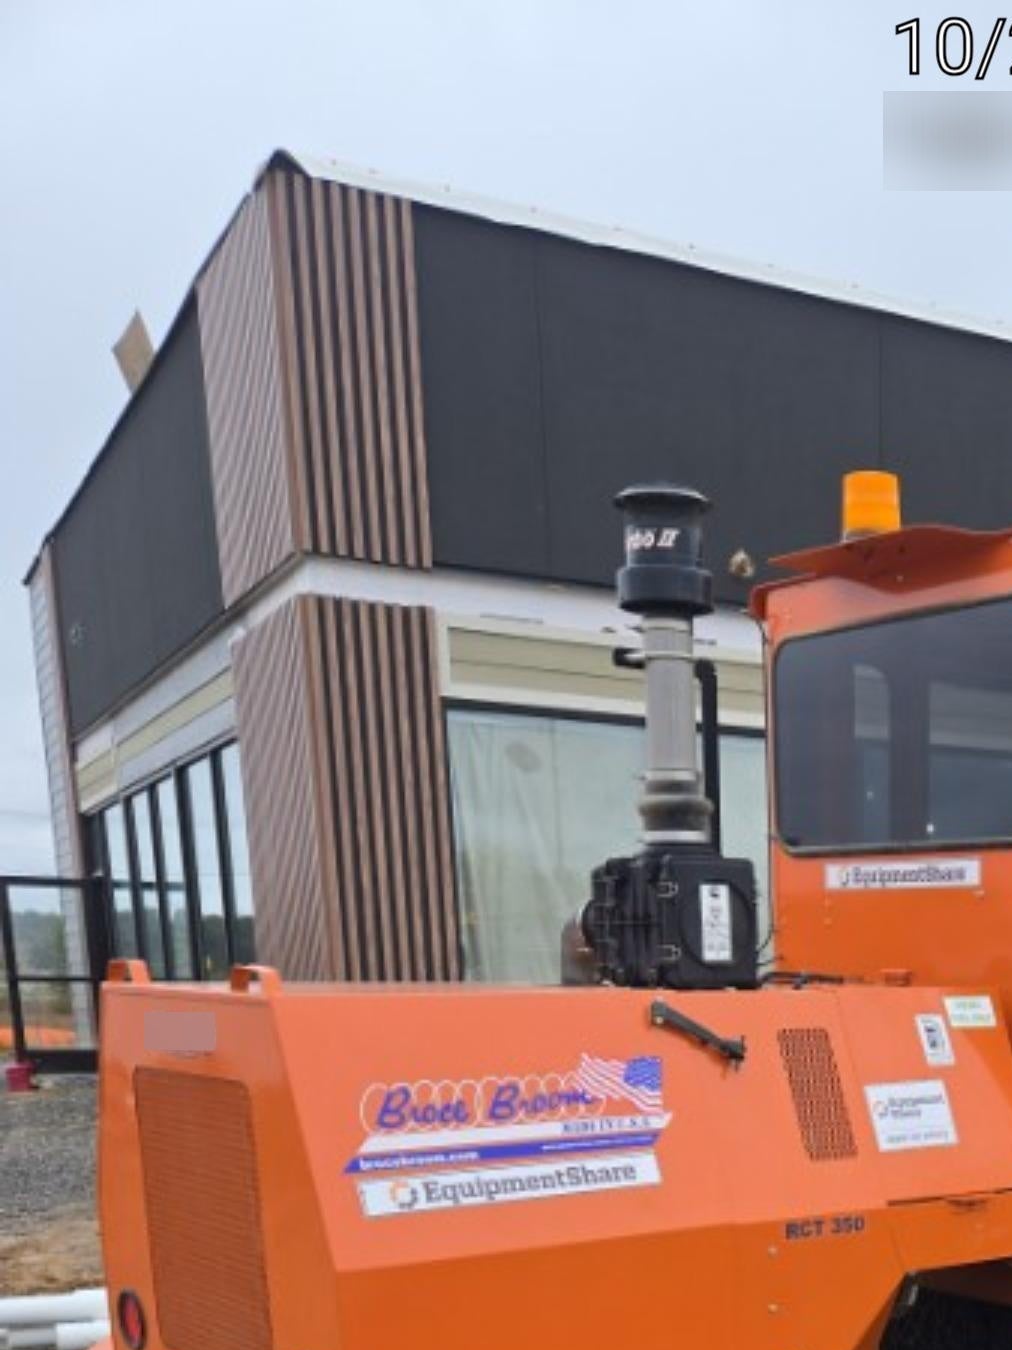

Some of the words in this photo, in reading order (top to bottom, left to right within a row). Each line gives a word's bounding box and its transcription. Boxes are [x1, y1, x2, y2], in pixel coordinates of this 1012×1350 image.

[422, 1164, 638, 1204] EquipmentShare
[785, 1219, 825, 1240] RCT
[831, 1215, 866, 1235] 350
